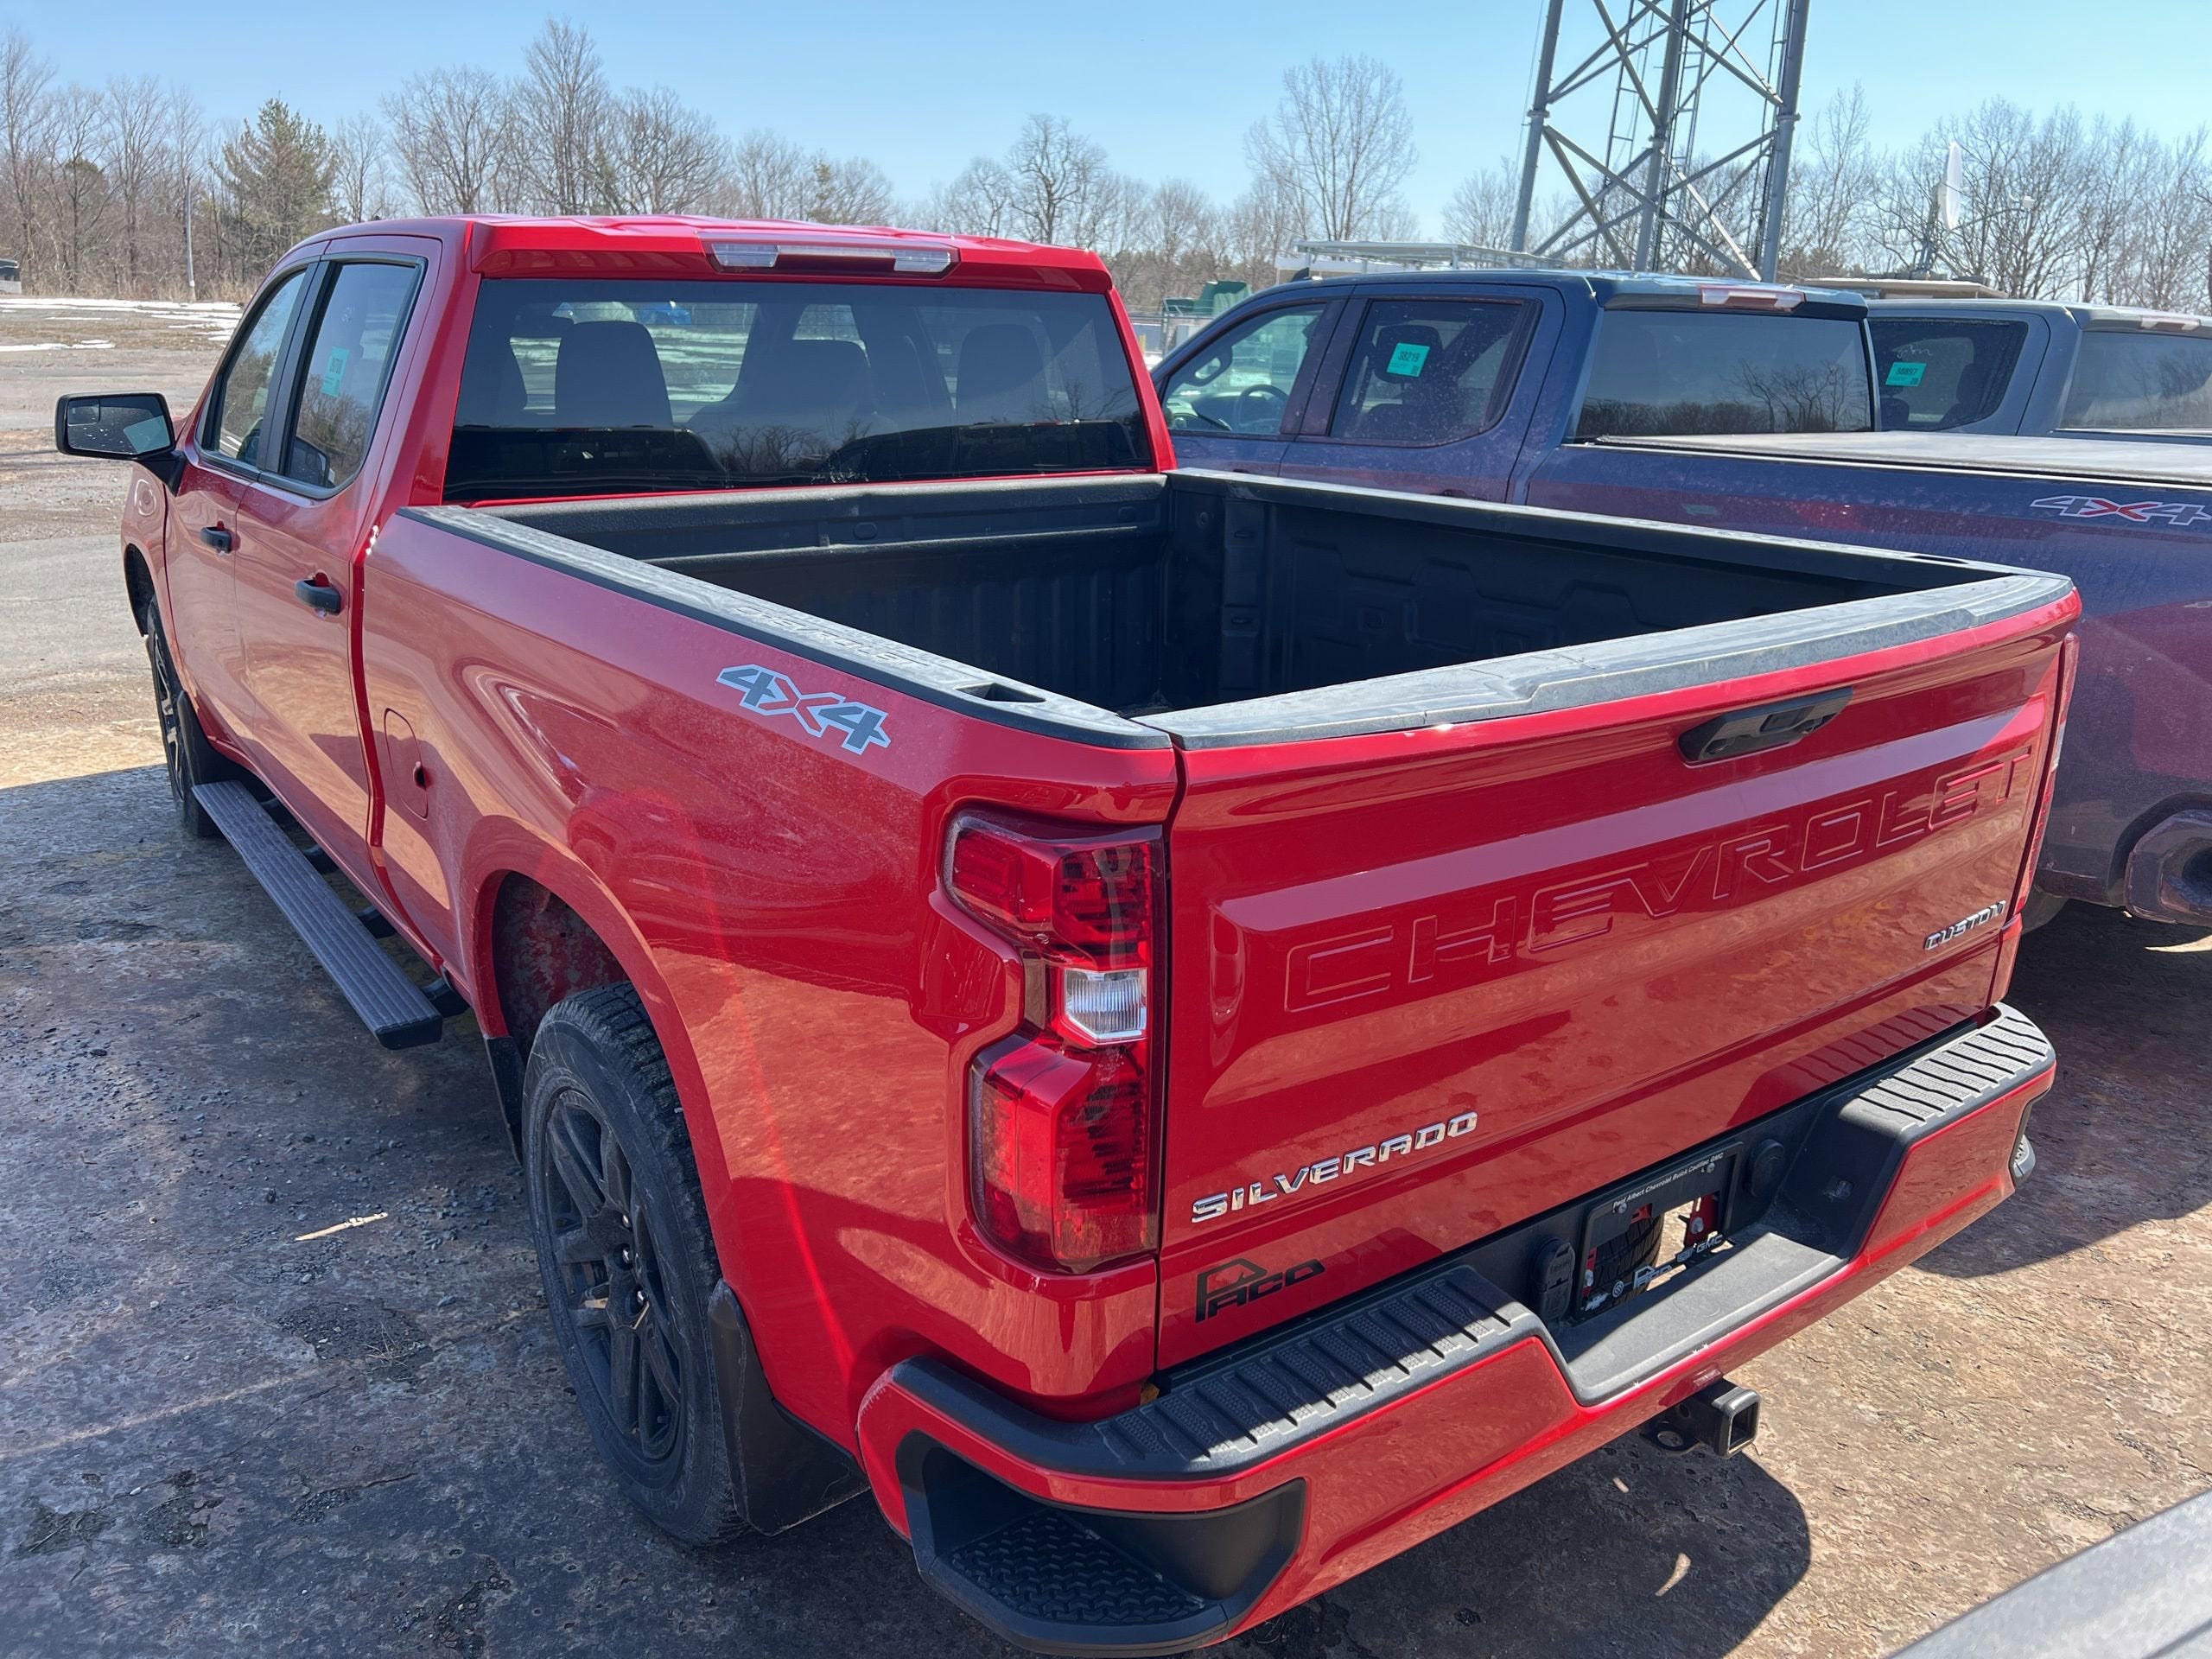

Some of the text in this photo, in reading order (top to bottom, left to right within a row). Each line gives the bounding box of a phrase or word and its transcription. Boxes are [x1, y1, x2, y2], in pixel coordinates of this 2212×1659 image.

[716, 664, 892, 755] 4X4
[1284, 745, 2032, 1014] CHEVROLET
[1923, 899, 2006, 950] CUSTOM
[1192, 1111, 1478, 1224] SILVERADO
[1645, 1176, 1673, 1193] Chevrolet
[1672, 1169, 1688, 1181] Buick
[1696, 1234, 1723, 1254] GMC
